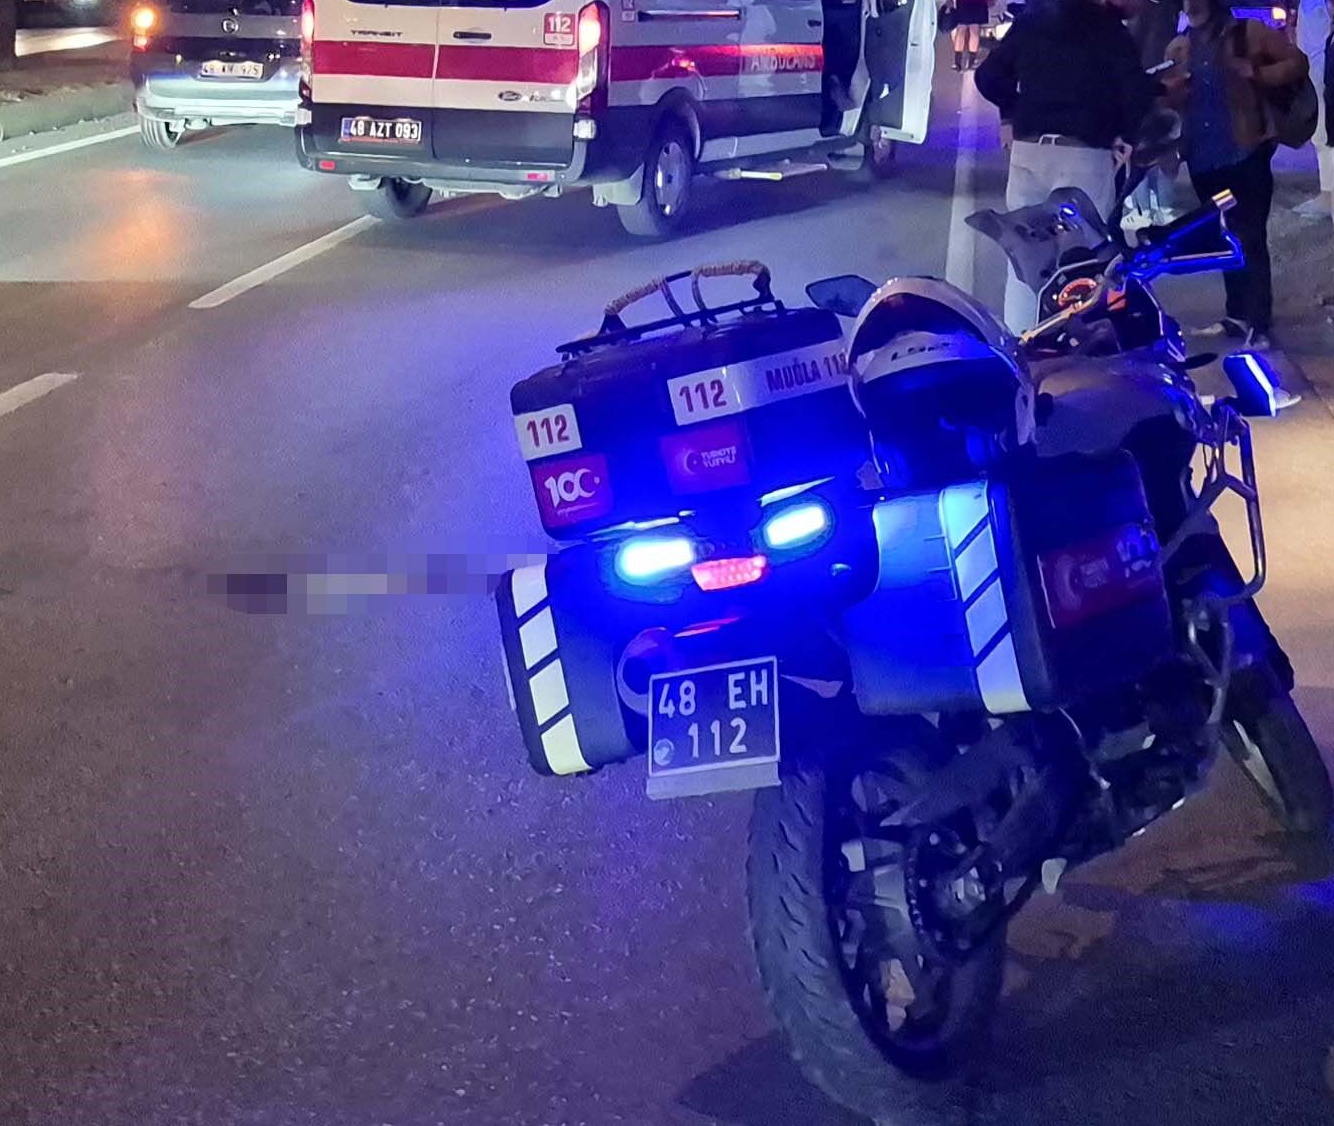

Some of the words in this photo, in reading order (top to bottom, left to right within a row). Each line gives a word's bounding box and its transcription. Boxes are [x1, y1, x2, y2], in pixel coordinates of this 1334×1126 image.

[547, 15, 571, 33] 112
[349, 119, 365, 137] 48
[369, 120, 392, 138] AZT
[395, 121, 418, 139] 093
[679, 378, 727, 412] 112
[526, 413, 569, 448] 112
[658, 680, 696, 718] 48
[728, 668, 768, 710] EH
[688, 717, 747, 759] 112
